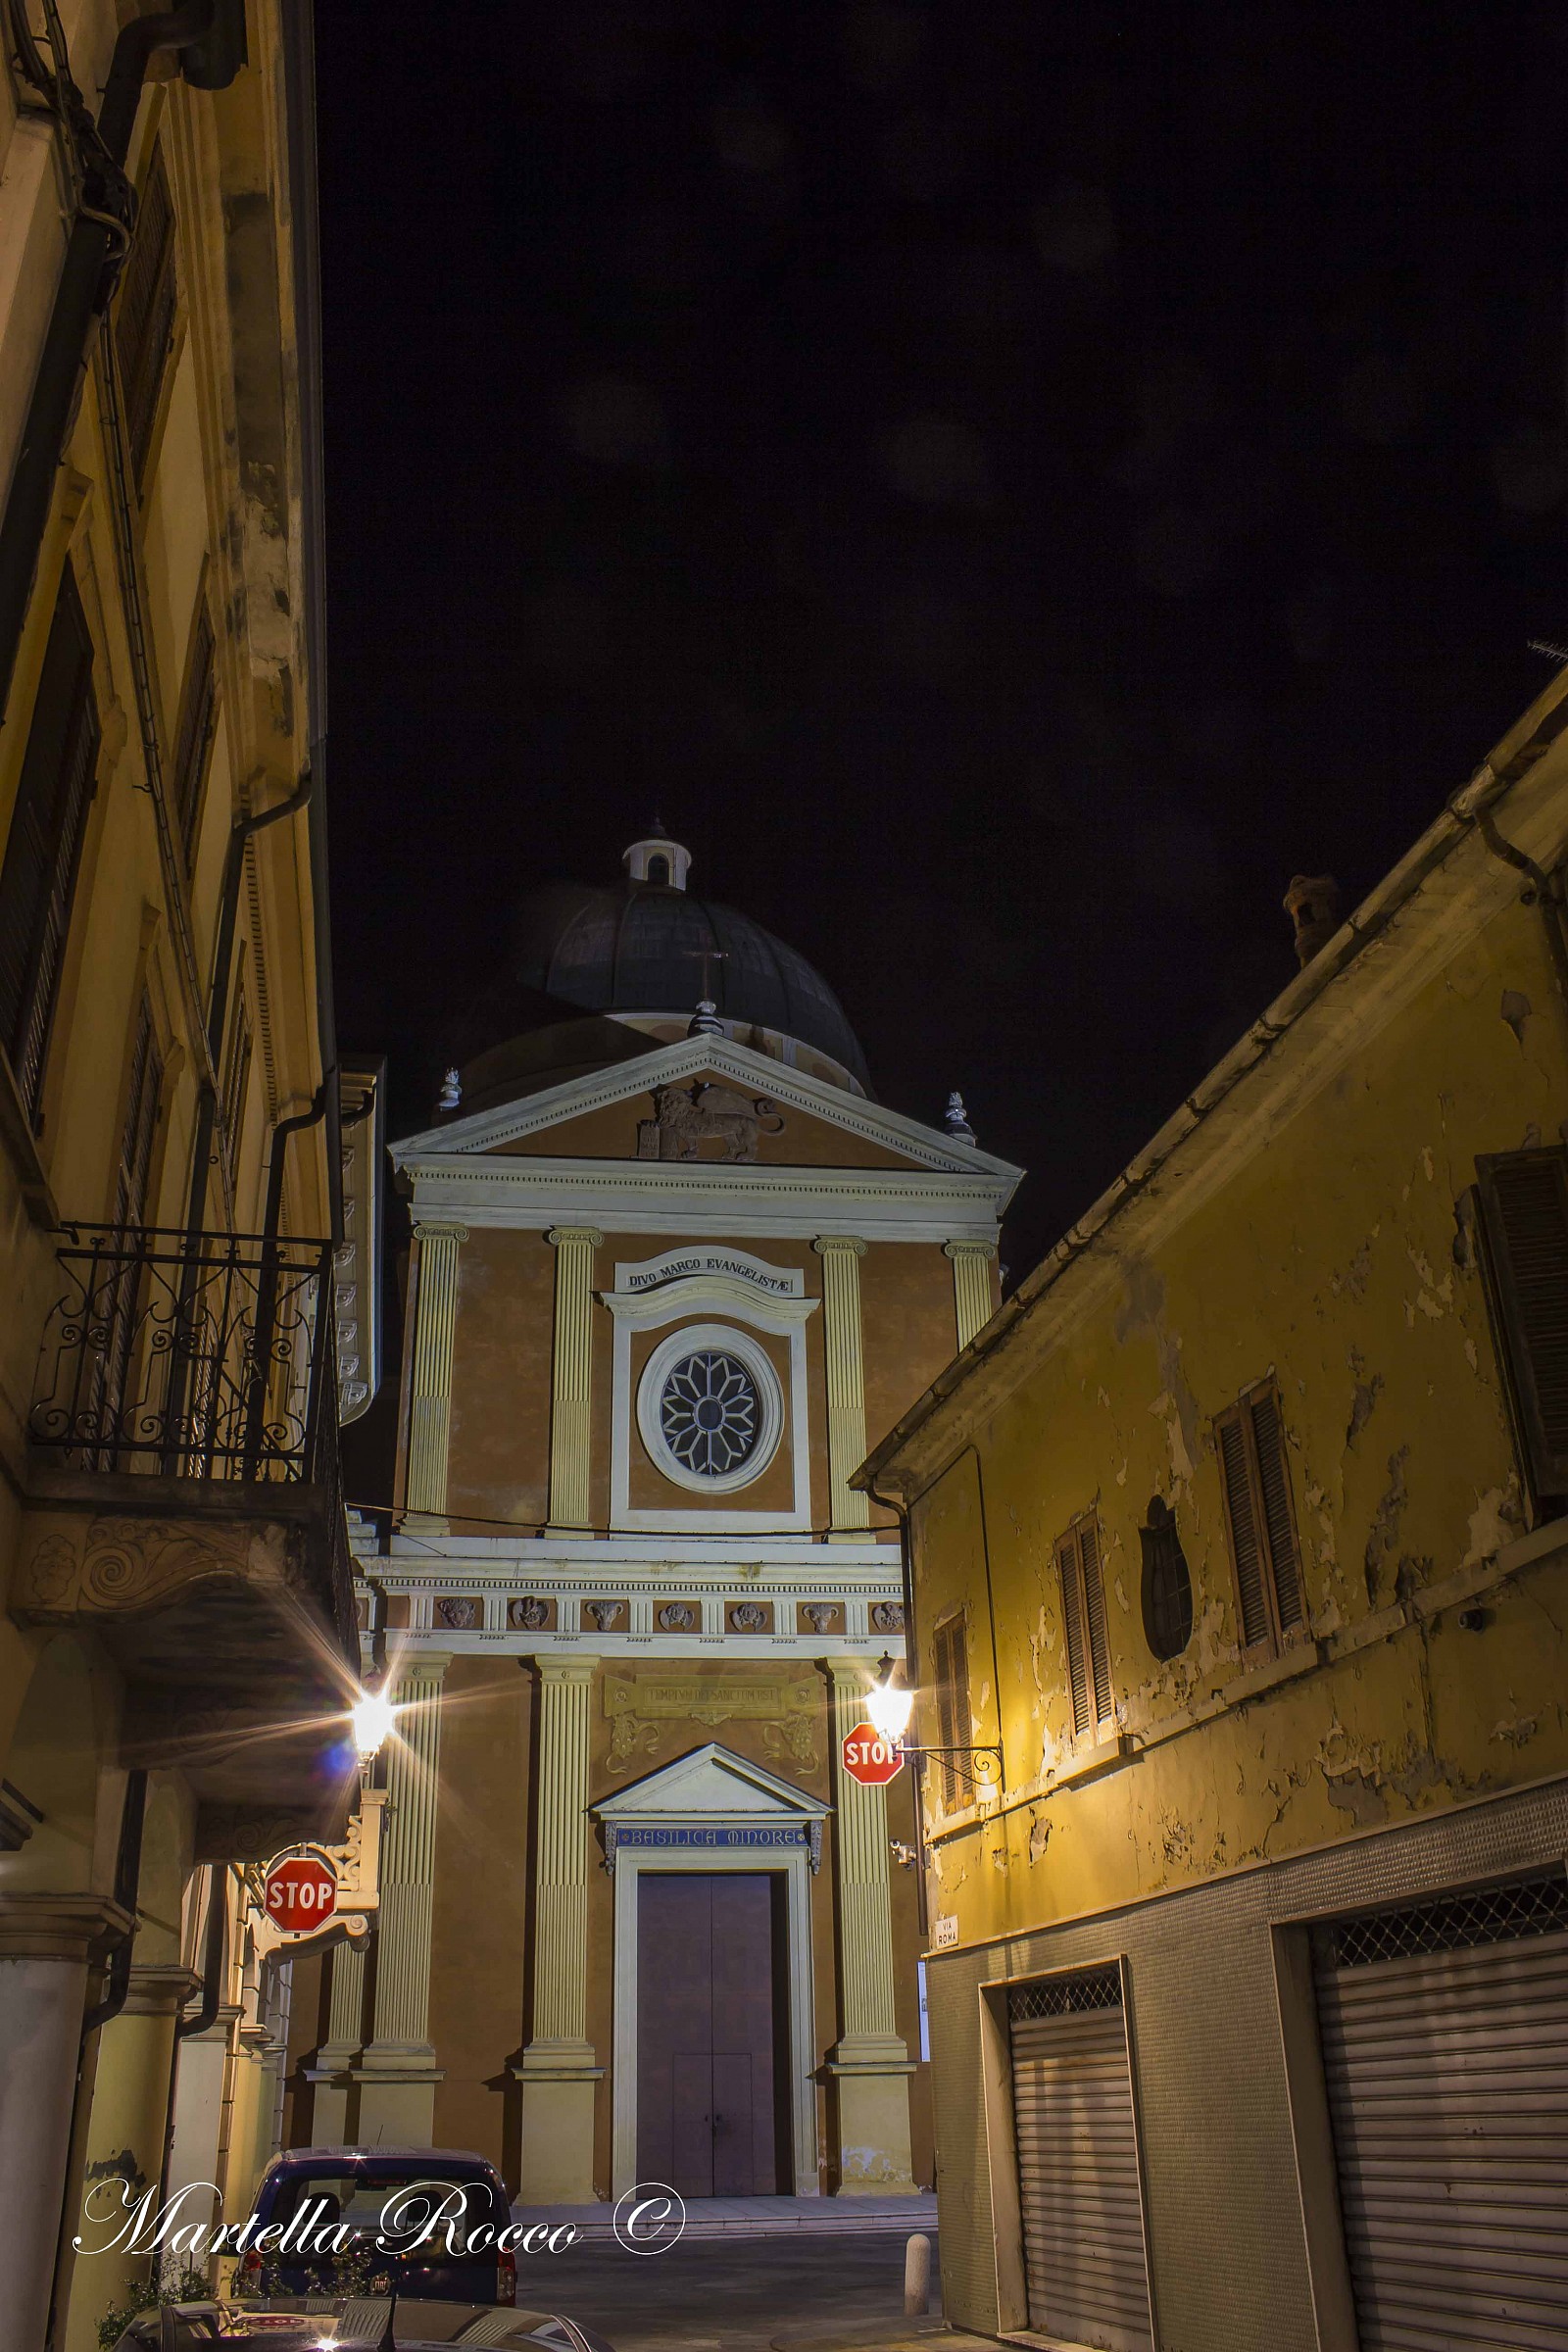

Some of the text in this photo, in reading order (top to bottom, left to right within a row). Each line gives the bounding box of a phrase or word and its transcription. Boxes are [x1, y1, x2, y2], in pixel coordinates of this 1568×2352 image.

[629, 1272, 657, 1286] DIVO
[661, 1258, 701, 1278] MARCO
[630, 1830, 797, 1845] BASILICA MINORE
[269, 1882, 333, 1910] STOP
[942, 1922, 952, 1932] VIA
[938, 1934, 956, 1945] ROMA
